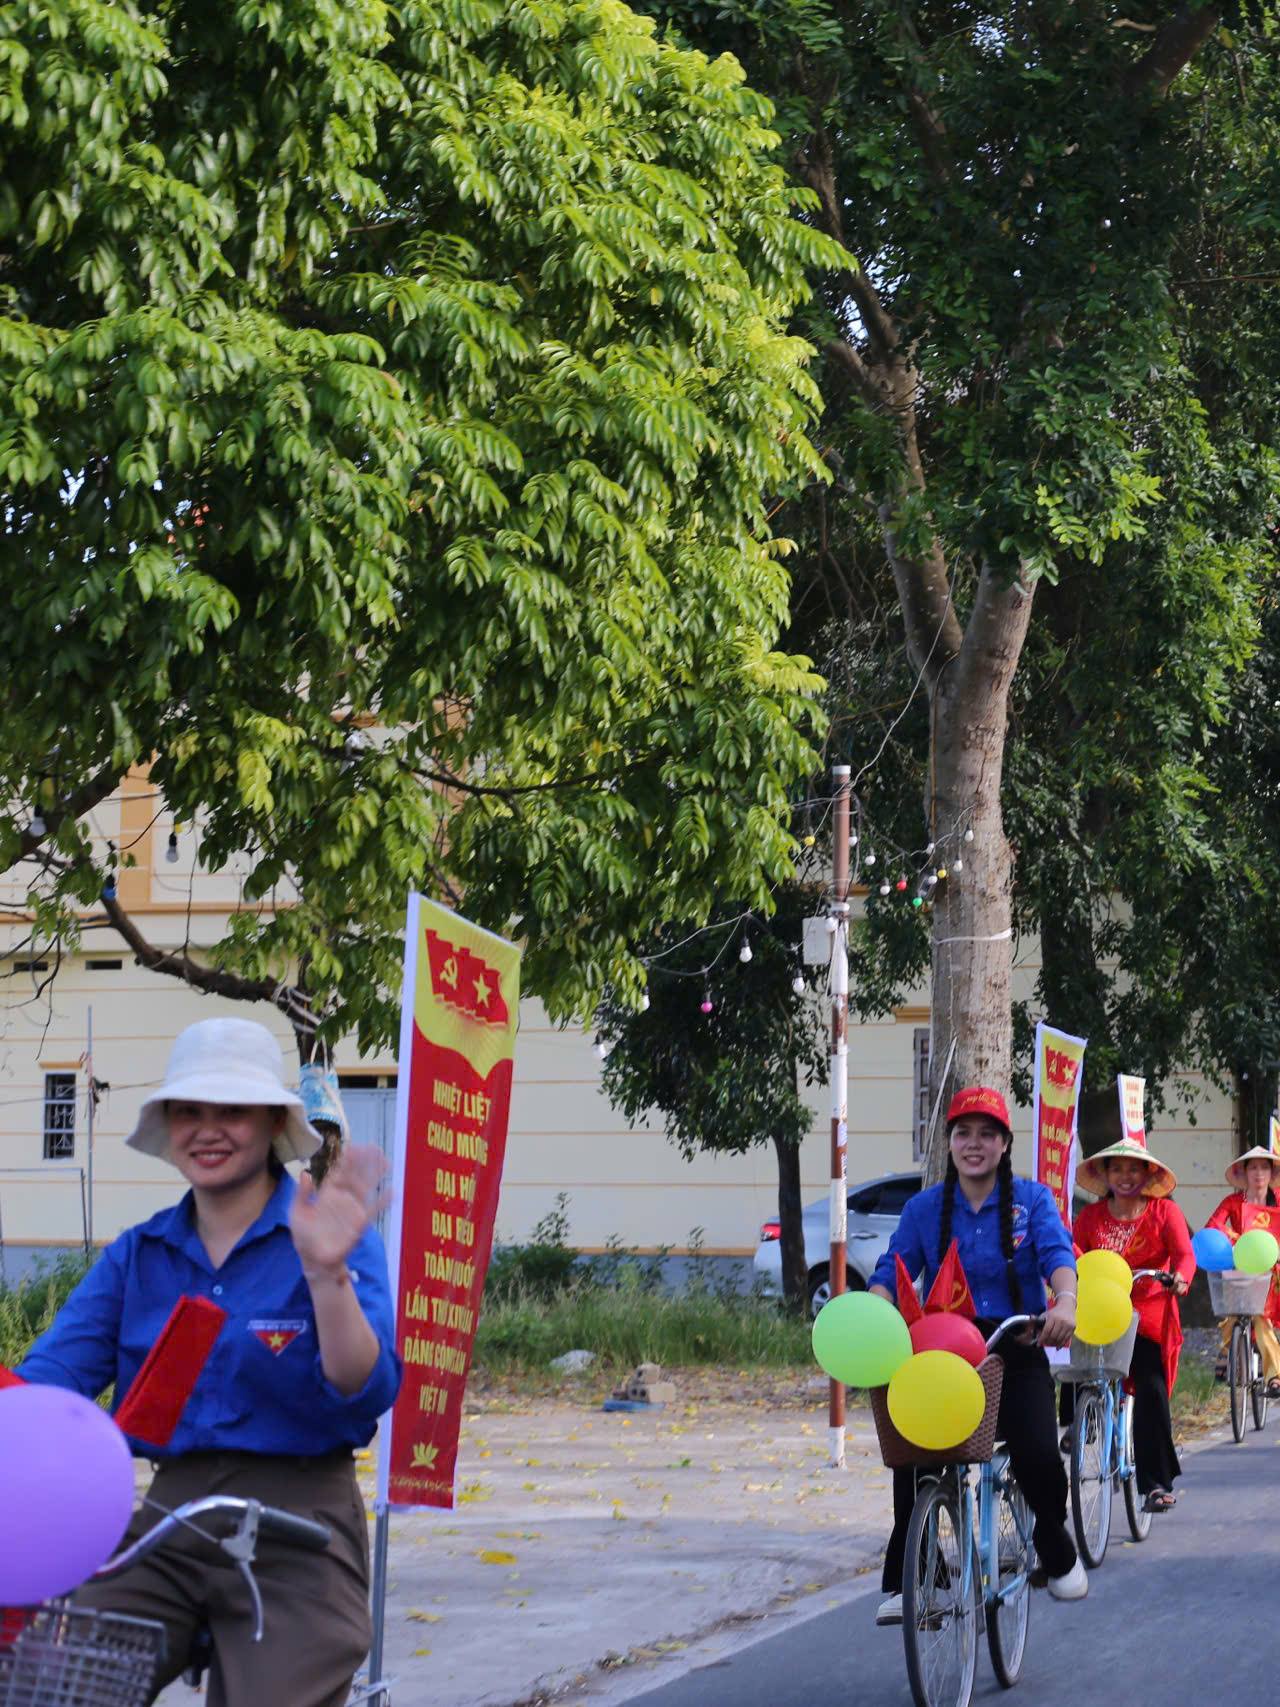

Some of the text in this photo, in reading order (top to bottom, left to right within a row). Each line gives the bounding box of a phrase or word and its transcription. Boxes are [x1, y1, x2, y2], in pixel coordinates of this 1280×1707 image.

[433, 1079, 491, 1126] NHIỆT LIỆT
[427, 1120, 454, 1154] CHÀO
[435, 1168, 456, 1202] ĐẠI
[432, 1210, 452, 1245] ĐẠI
